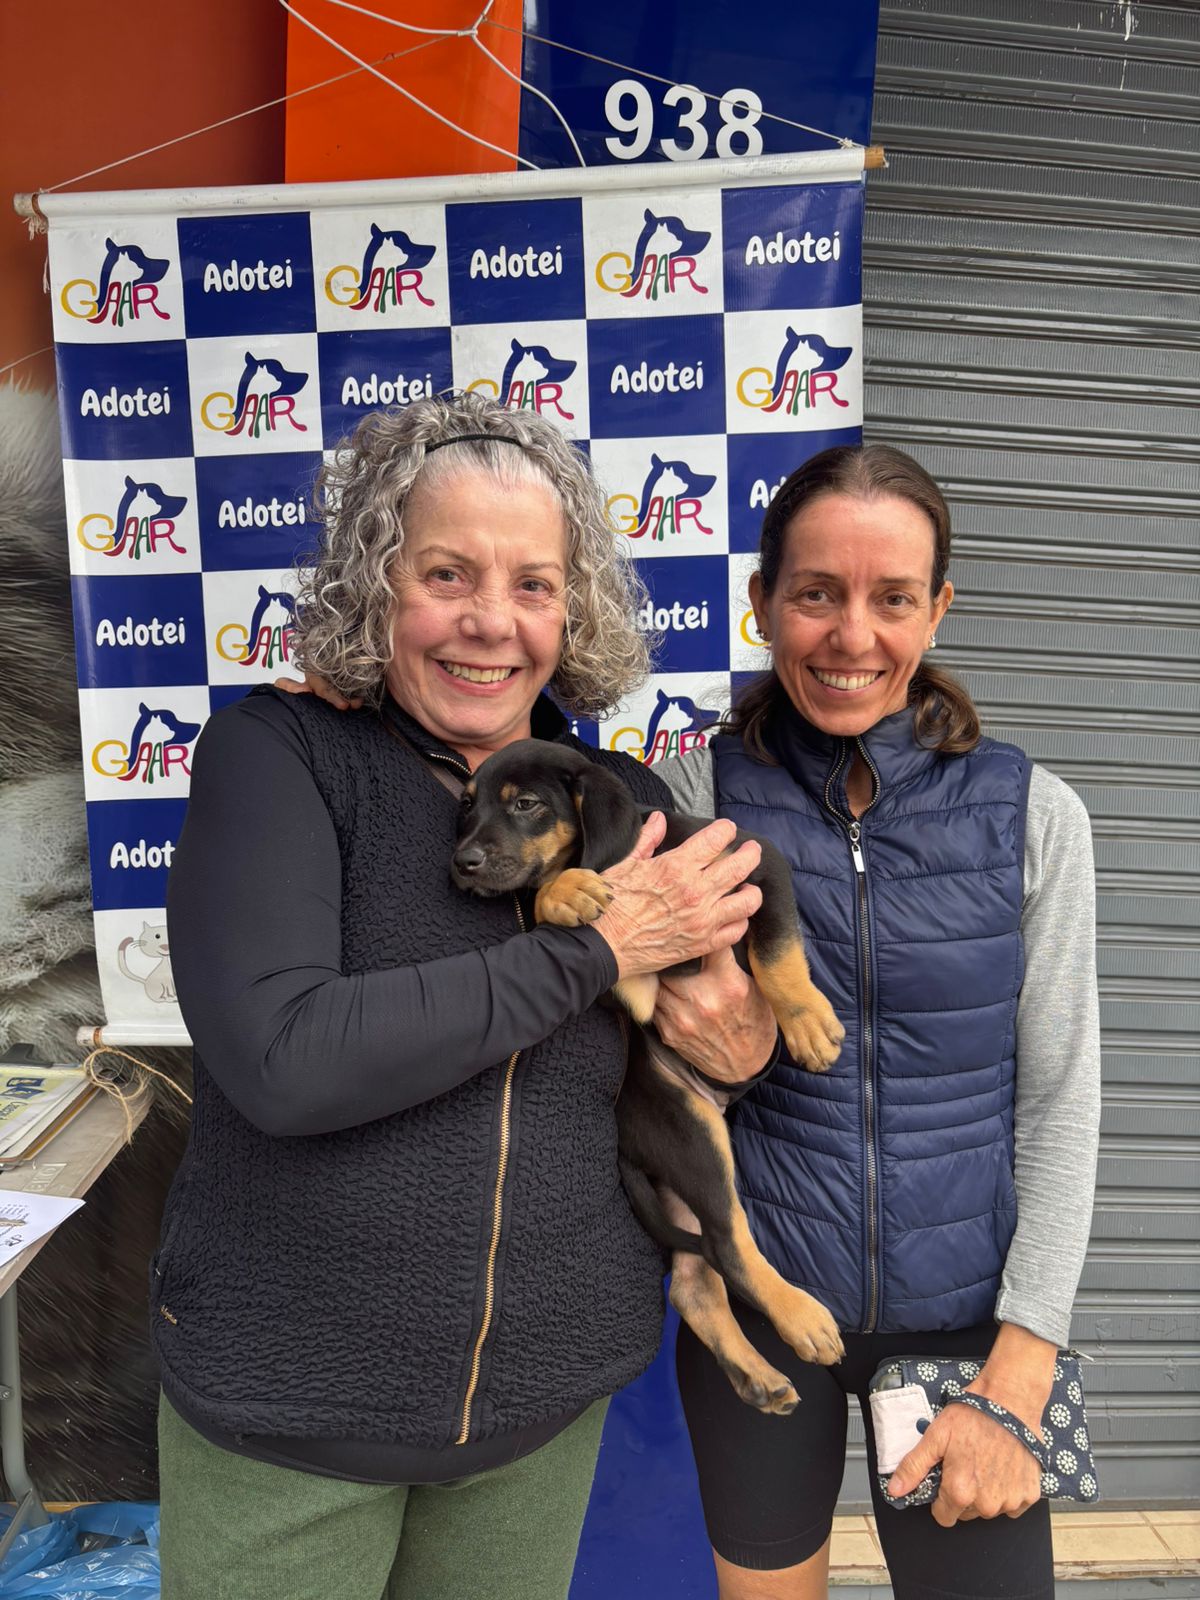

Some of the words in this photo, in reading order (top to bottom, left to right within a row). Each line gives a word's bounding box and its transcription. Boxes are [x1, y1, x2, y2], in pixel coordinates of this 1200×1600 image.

[604, 79, 764, 162] 938
[469, 245, 563, 280] Adotei
[744, 231, 841, 266] Adotei
[203, 259, 294, 293] Adotei
[324, 264, 436, 314] GAAR
[595, 251, 709, 301] GAAR
[60, 278, 171, 328] GAAR
[341, 373, 433, 406] Adotei
[610, 361, 705, 395] Adotei
[736, 367, 850, 416] GAAR
[80, 386, 171, 418] Adotei
[200, 391, 308, 439] GAAR
[218, 497, 306, 529] Adotei
[604, 493, 714, 542] GAAR
[75, 512, 187, 561] GAAR
[96, 617, 186, 648] Adotei
[637, 600, 709, 631] dotei
[91, 739, 192, 785] GAAR
[110, 839, 176, 869] Adot
